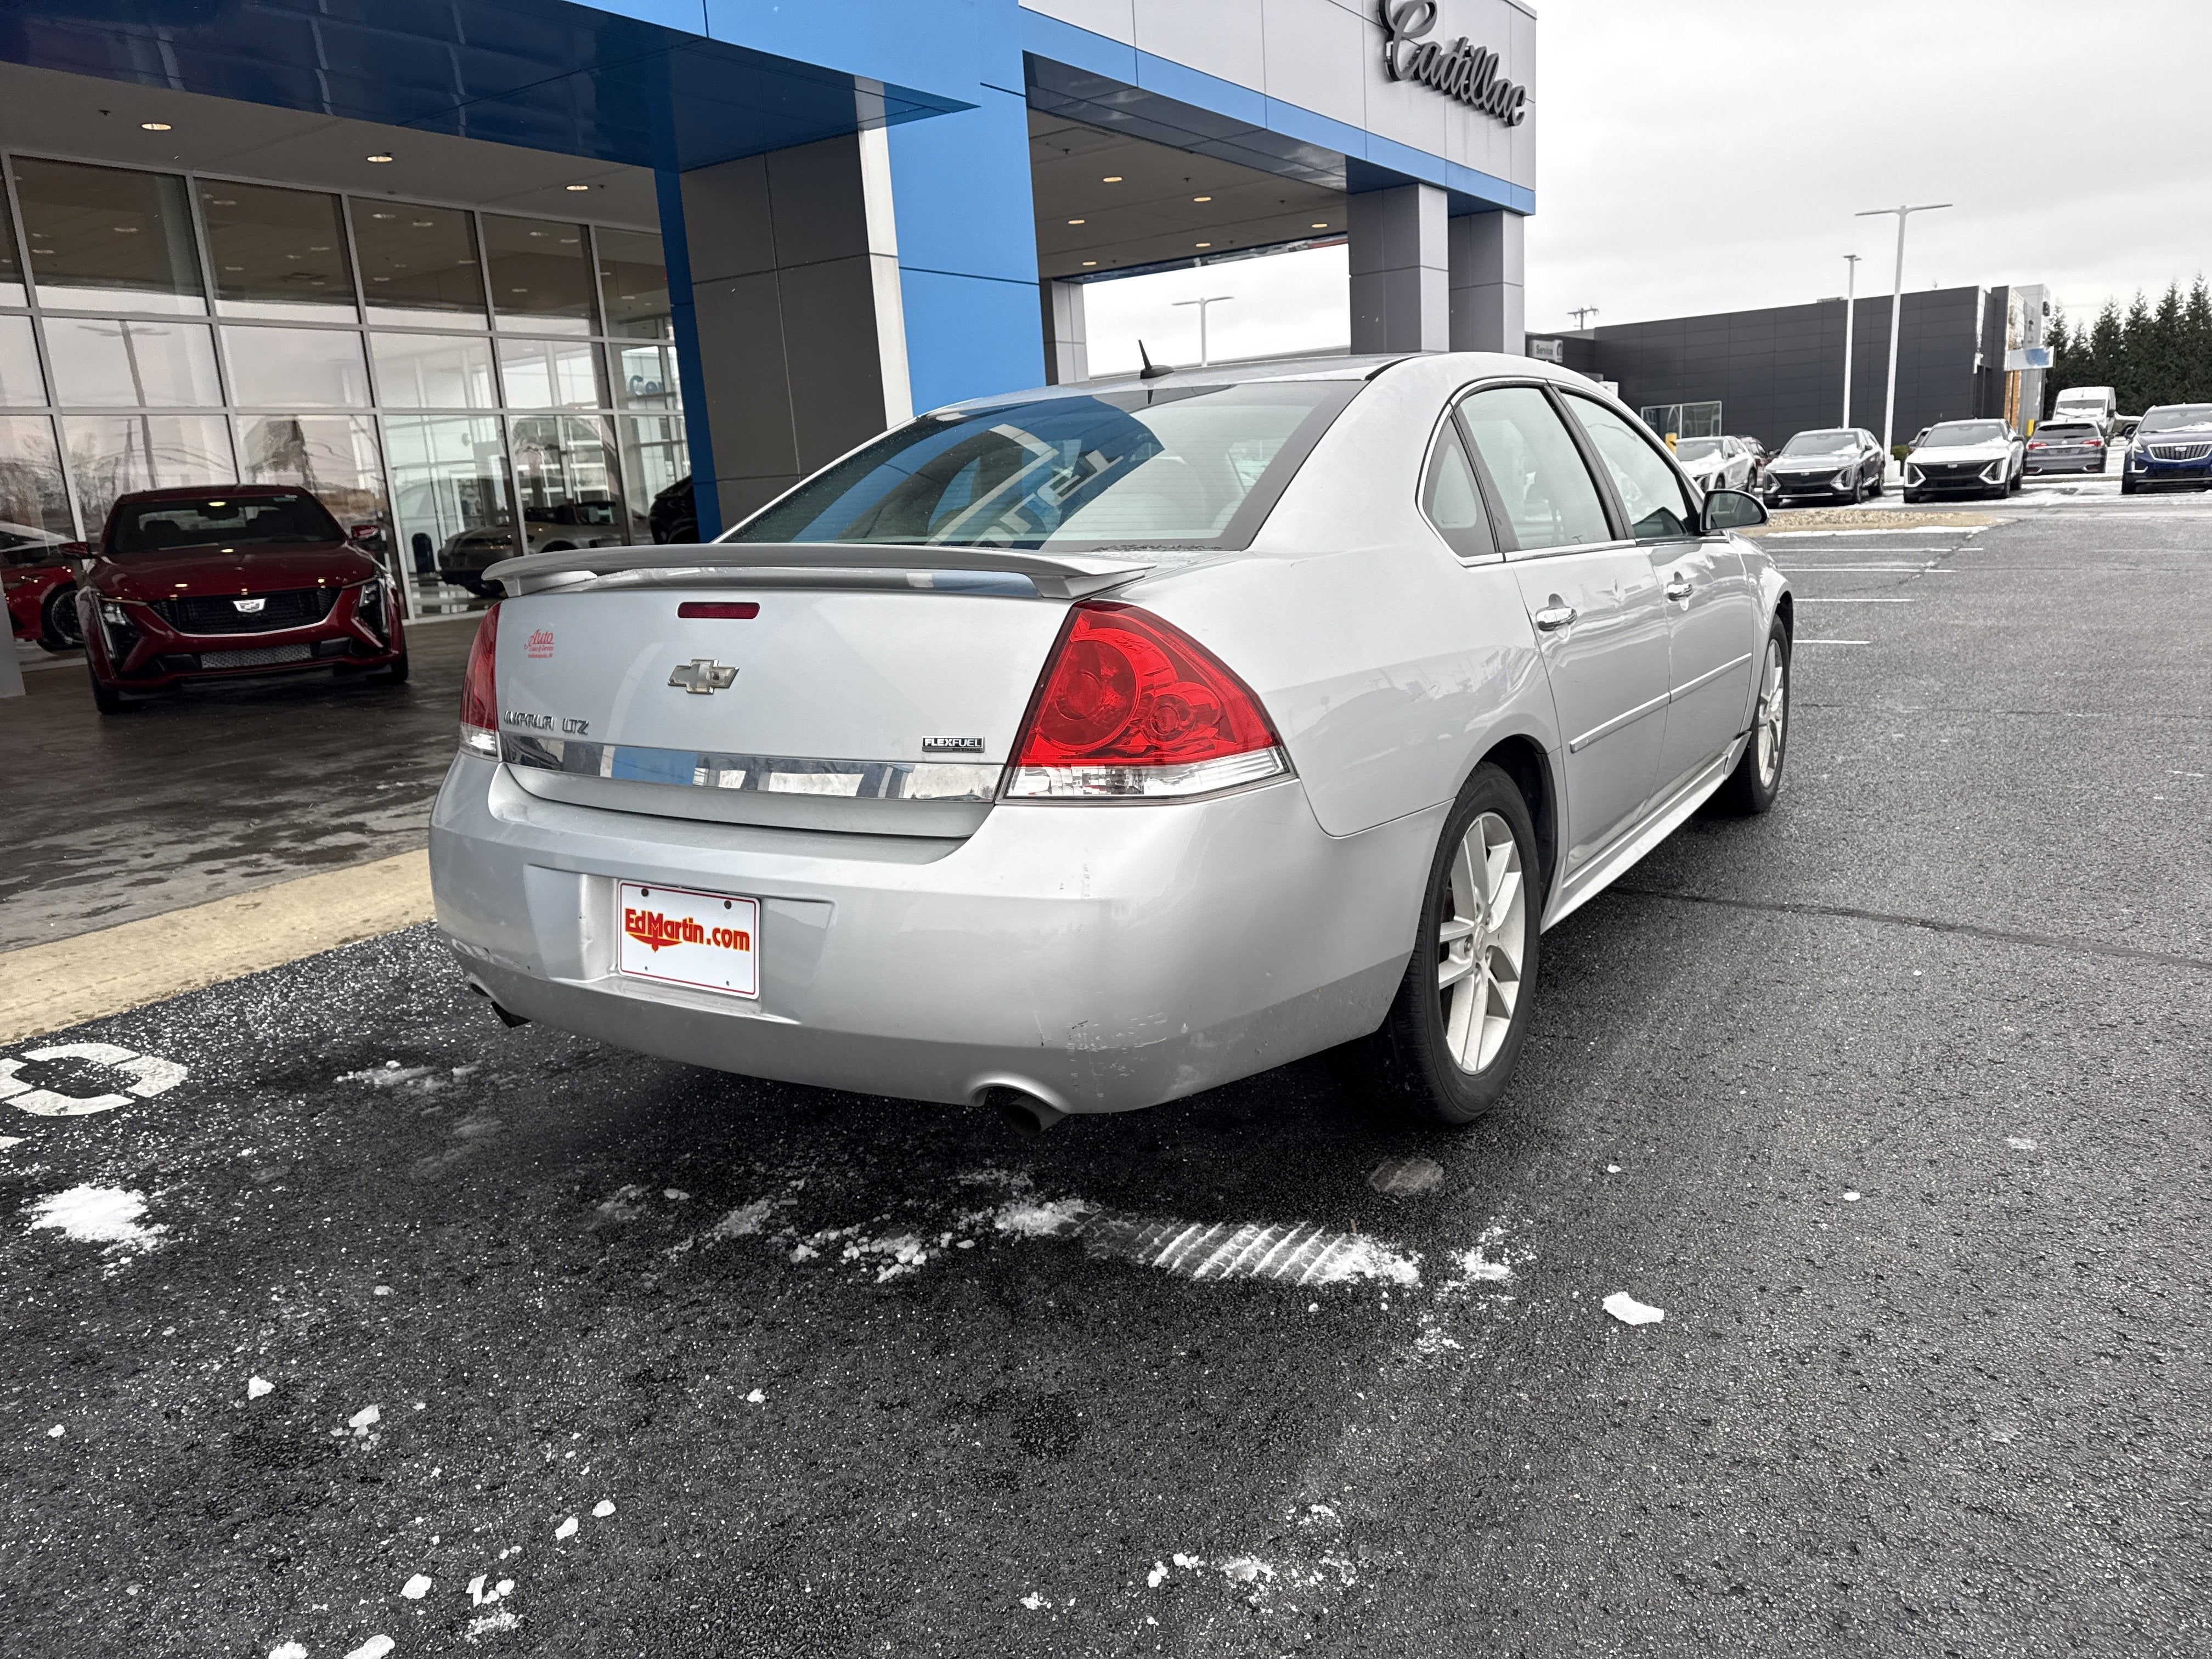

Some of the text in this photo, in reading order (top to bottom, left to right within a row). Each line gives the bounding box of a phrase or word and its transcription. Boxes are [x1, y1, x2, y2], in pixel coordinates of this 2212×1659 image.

[1377, 0, 1526, 126] Cadillac
[524, 629, 554, 650] Auto
[504, 710, 589, 735] IMPALA LTZ
[924, 738, 981, 747] FLEXFUEL
[625, 908, 750, 952] EdMartin.com
